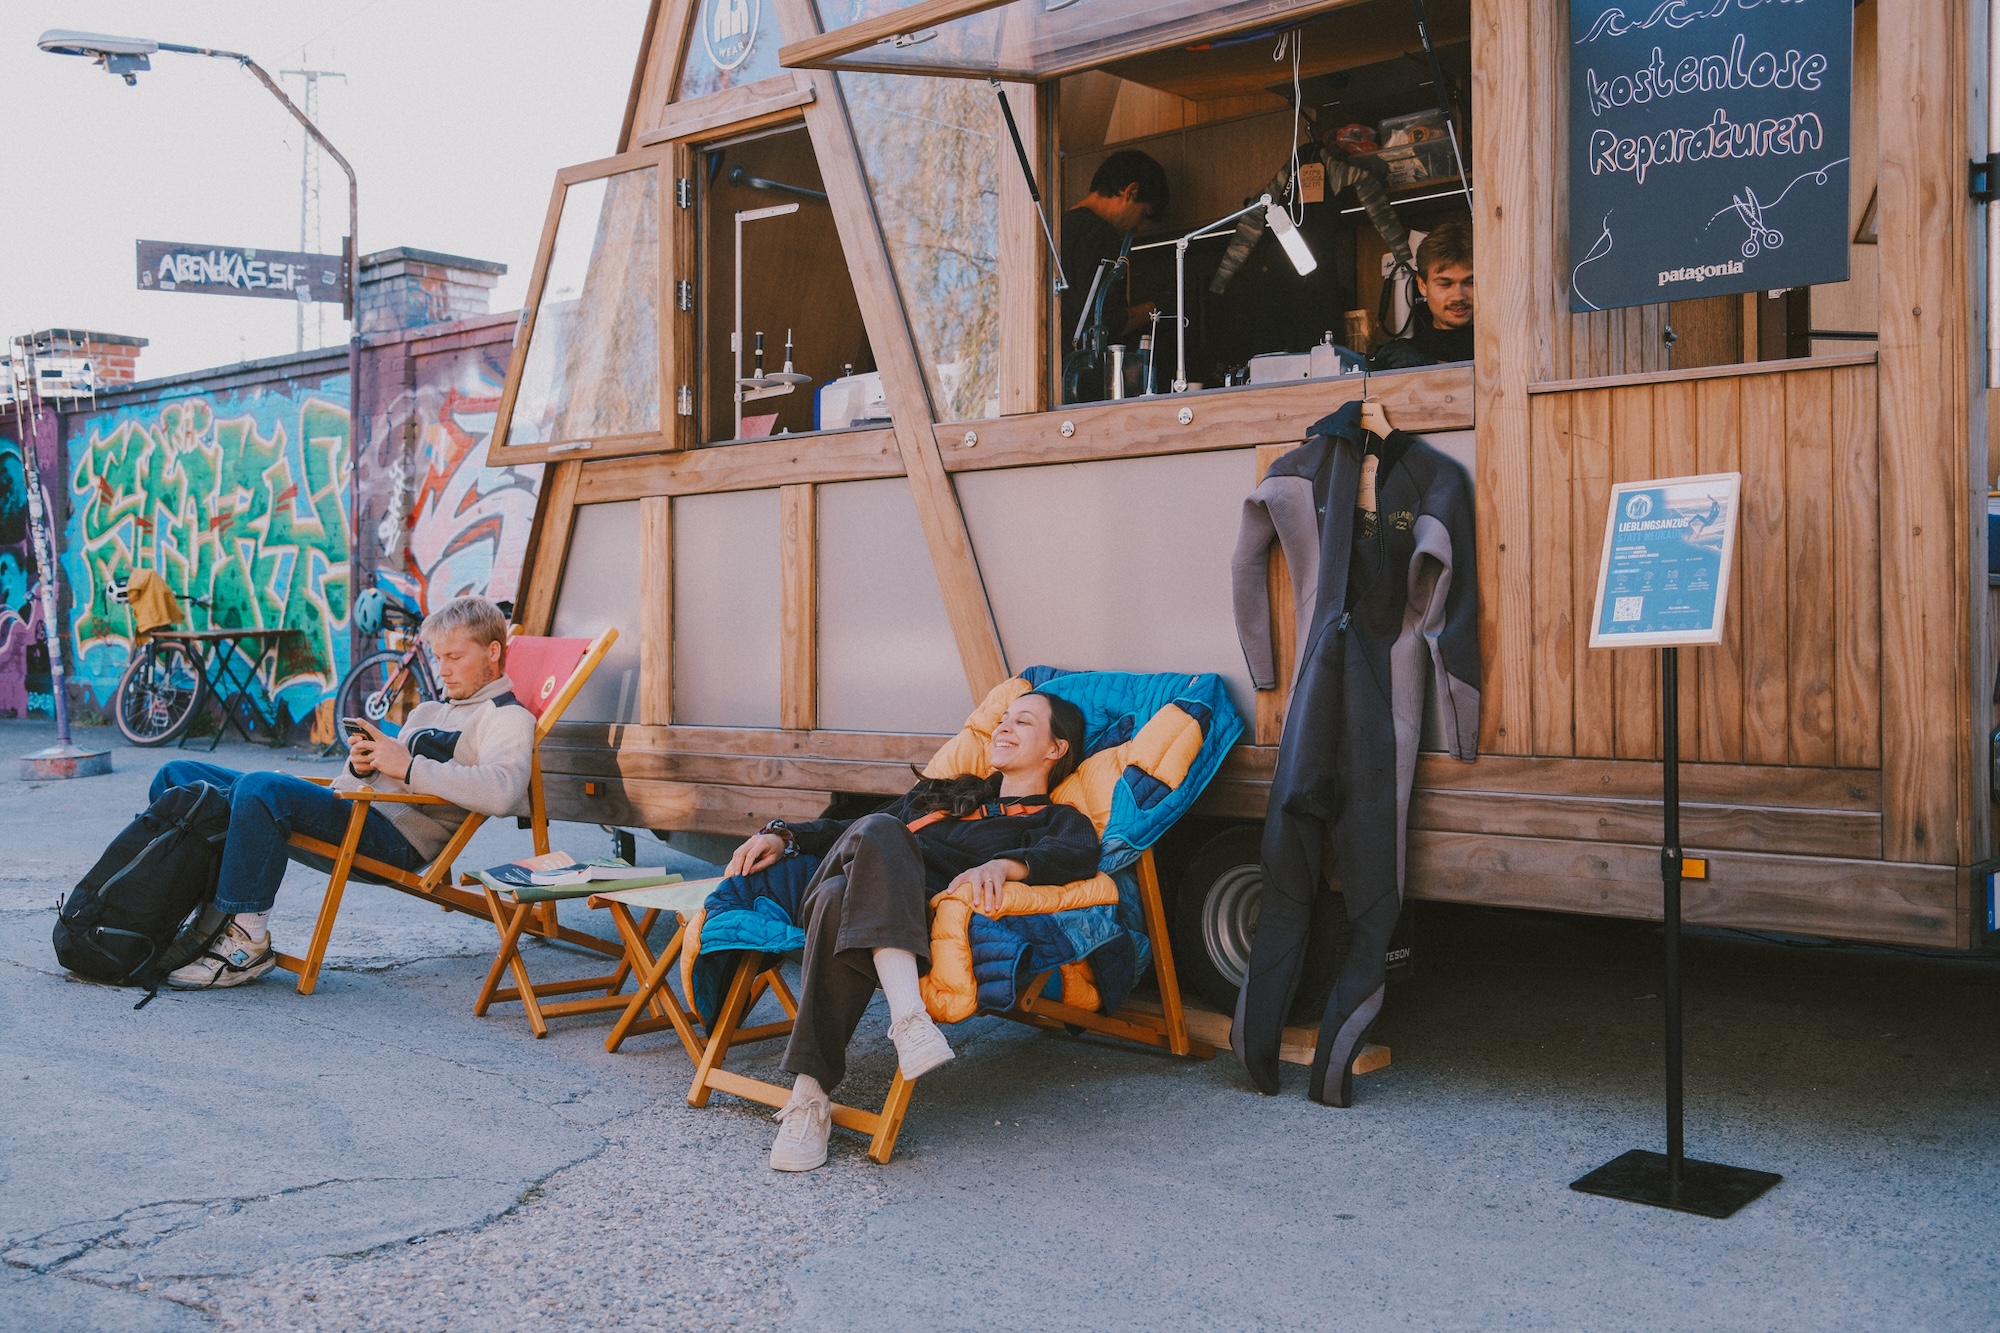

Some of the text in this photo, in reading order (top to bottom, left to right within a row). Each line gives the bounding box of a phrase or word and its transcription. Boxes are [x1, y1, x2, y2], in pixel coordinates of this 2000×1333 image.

[719, 41, 745, 57] WEAR
[1587, 33, 1827, 117] kostenlose
[1589, 108, 1824, 185] Reparaturen
[1657, 260, 1744, 286] patagonia
[1618, 517, 1689, 532] LIEBLINGSANZUG
[1617, 532, 1643, 543] STATT
